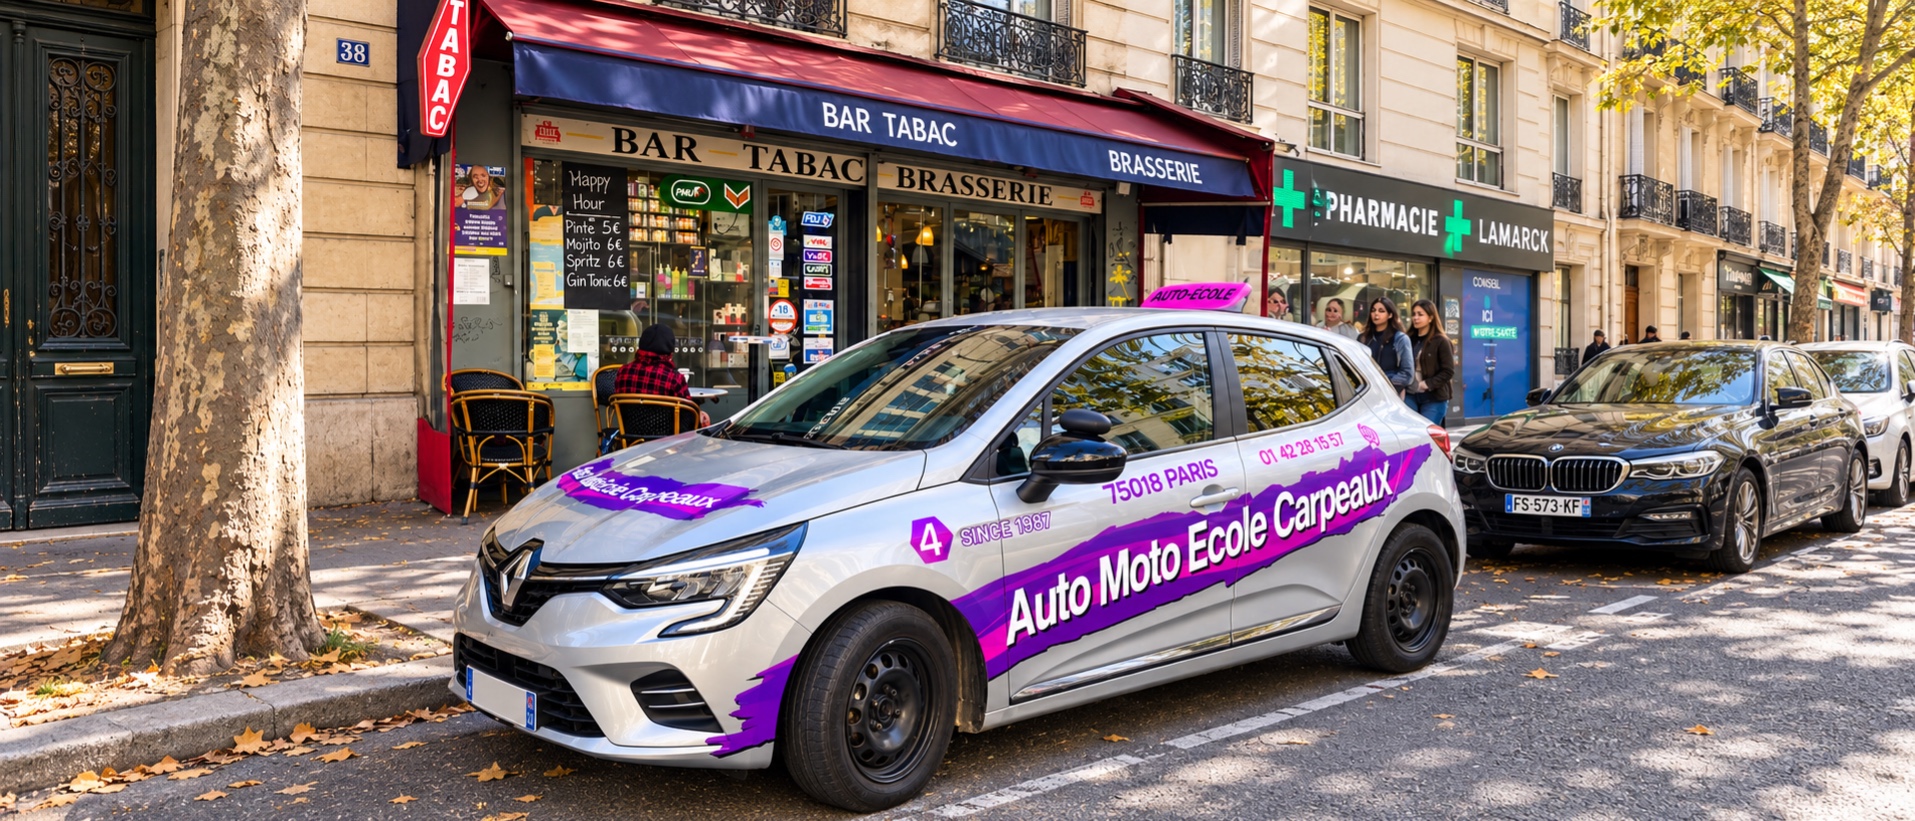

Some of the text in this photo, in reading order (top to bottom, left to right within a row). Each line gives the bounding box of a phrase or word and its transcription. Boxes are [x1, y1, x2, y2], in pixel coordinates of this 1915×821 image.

[340, 42, 366, 63] 38
[430, 0, 465, 130] TABAC
[821, 101, 958, 147] BAR TABAC
[612, 126, 702, 162] BAR
[743, 143, 864, 183] TABAC
[1108, 150, 1203, 185] BRASSERIE
[568, 170, 611, 195] Happy
[896, 166, 1053, 206] BRASSERIE
[572, 193, 606, 211] Hour
[565, 219, 621, 235] Pinte 5€
[1326, 190, 1549, 253] PHARMACIE LAMARCK
[566, 237, 623, 255] Mojito 6€
[566, 253, 625, 272] Spritz 6€
[566, 272, 628, 288] Gin Tonic 6€
[1482, 309, 1493, 322] ICI
[1259, 448, 1279, 466] 01
[1280, 444, 1298, 460] 42
[1296, 439, 1315, 456] 28
[1314, 435, 1330, 451] 15
[1327, 431, 1345, 447] 57
[1102, 459, 1219, 505] 75018 PARIS
[1513, 496, 1581, 514] FS-573-KF
[919, 521, 943, 557] 4
[960, 511, 1052, 548] SINCE 1987
[1006, 460, 1393, 647] Auto Moto Ecole Carpeaux
